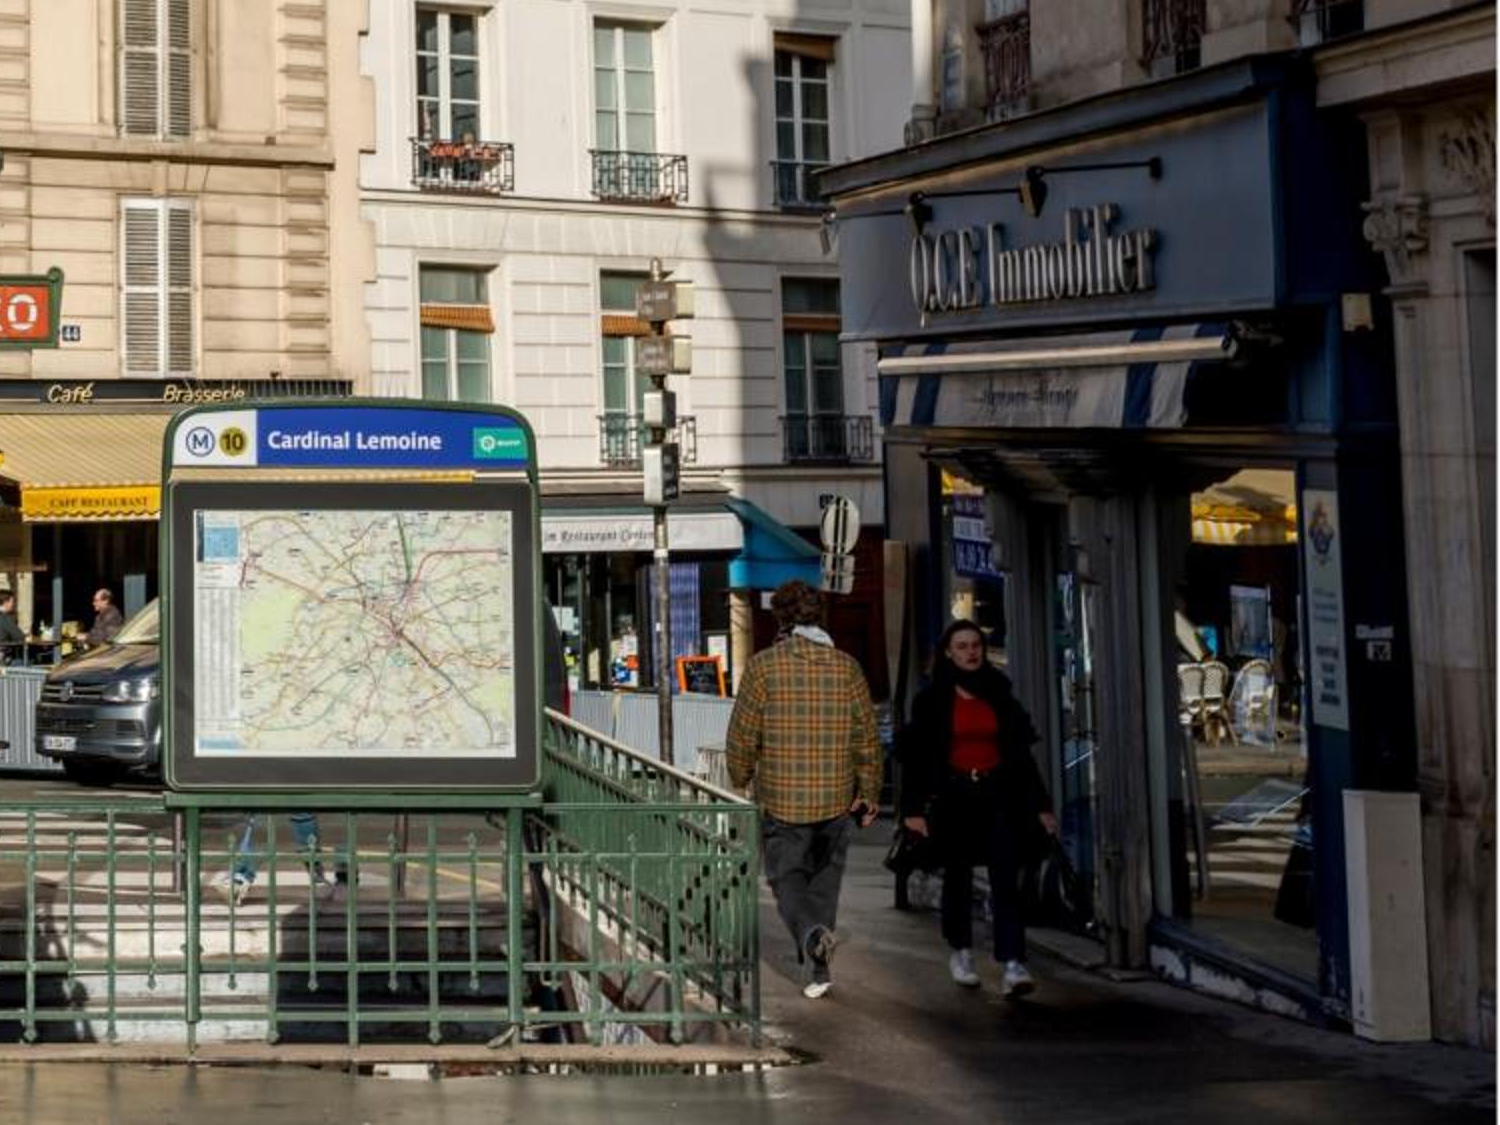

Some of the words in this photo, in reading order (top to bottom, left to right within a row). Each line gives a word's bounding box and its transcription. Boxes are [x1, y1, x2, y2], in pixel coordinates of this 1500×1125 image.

[987, 204, 1157, 306] Immobilier
[47, 382, 94, 403] Café
[163, 384, 245, 404] Brasserie
[222, 432, 245, 451] 10
[267, 430, 350, 451] Cardinal
[357, 430, 442, 451] Lemoine
[80, 496, 148, 508] RESTAURANT
